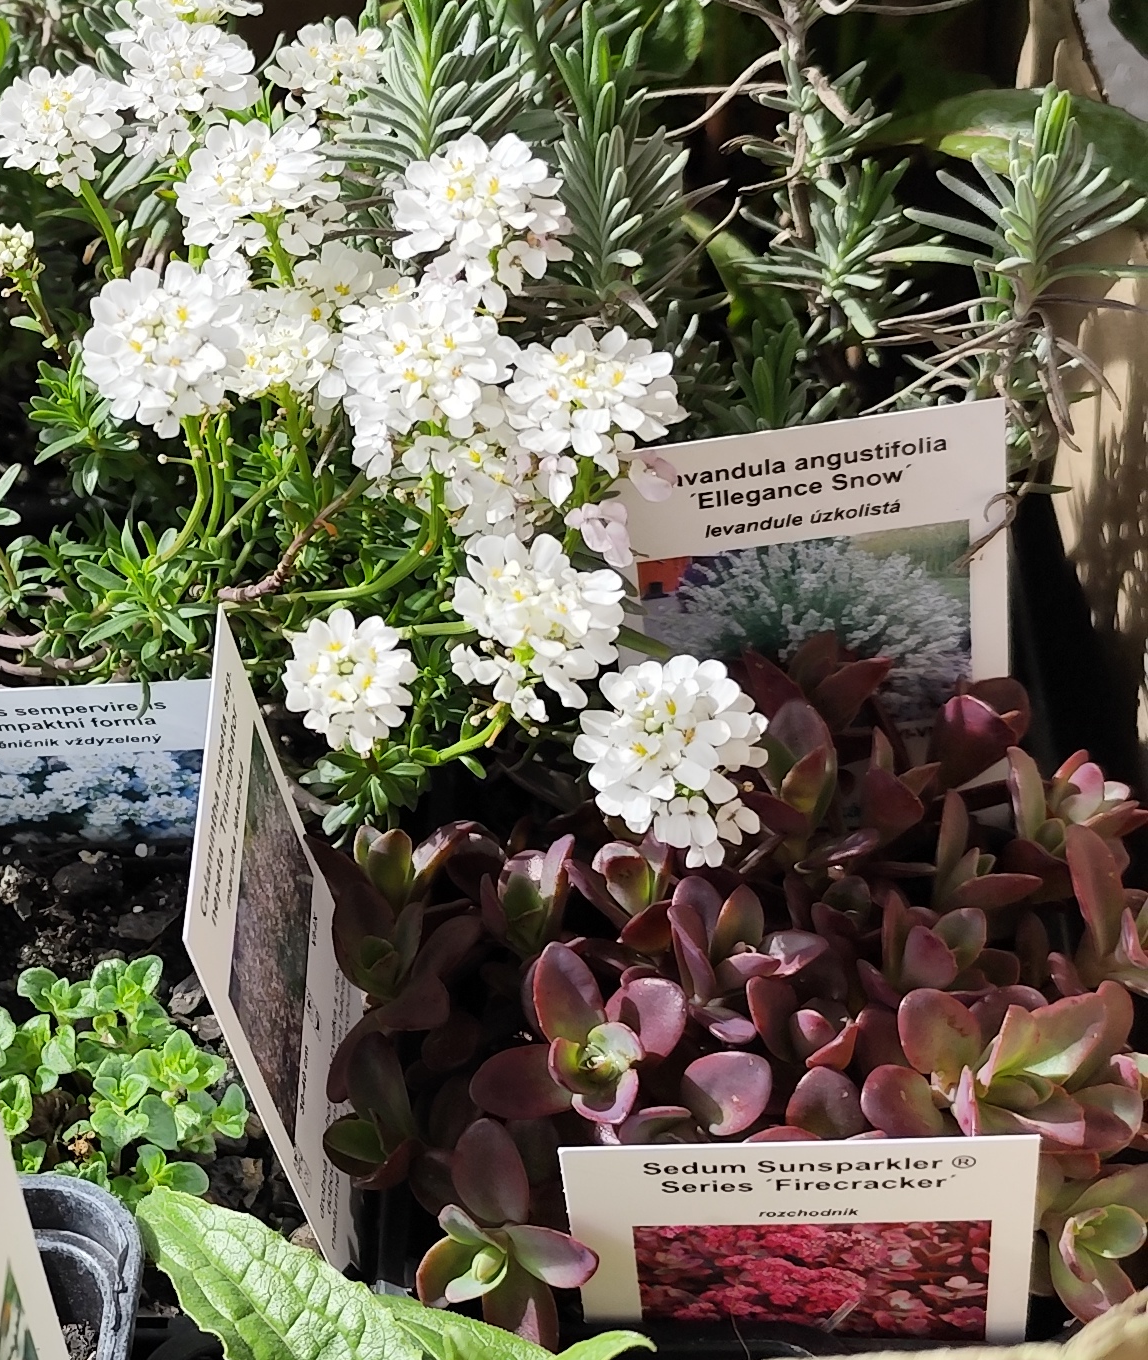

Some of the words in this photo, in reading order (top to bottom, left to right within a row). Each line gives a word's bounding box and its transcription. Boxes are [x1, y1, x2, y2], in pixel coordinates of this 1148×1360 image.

[677, 458, 786, 488] vandula
[794, 436, 948, 472] angustifolia
[704, 512, 803, 539] levandule
[809, 498, 901, 525] úzkolistá
[14, 701, 167, 717] sempervires
[90, 716, 157, 728] forma
[64, 733, 162, 747] vždyzelený
[200, 789, 220, 917] Calamintha
[642, 1160, 747, 1176] Sedum
[756, 1156, 944, 1175] Sunsparkler
[660, 1179, 754, 1194] Series
